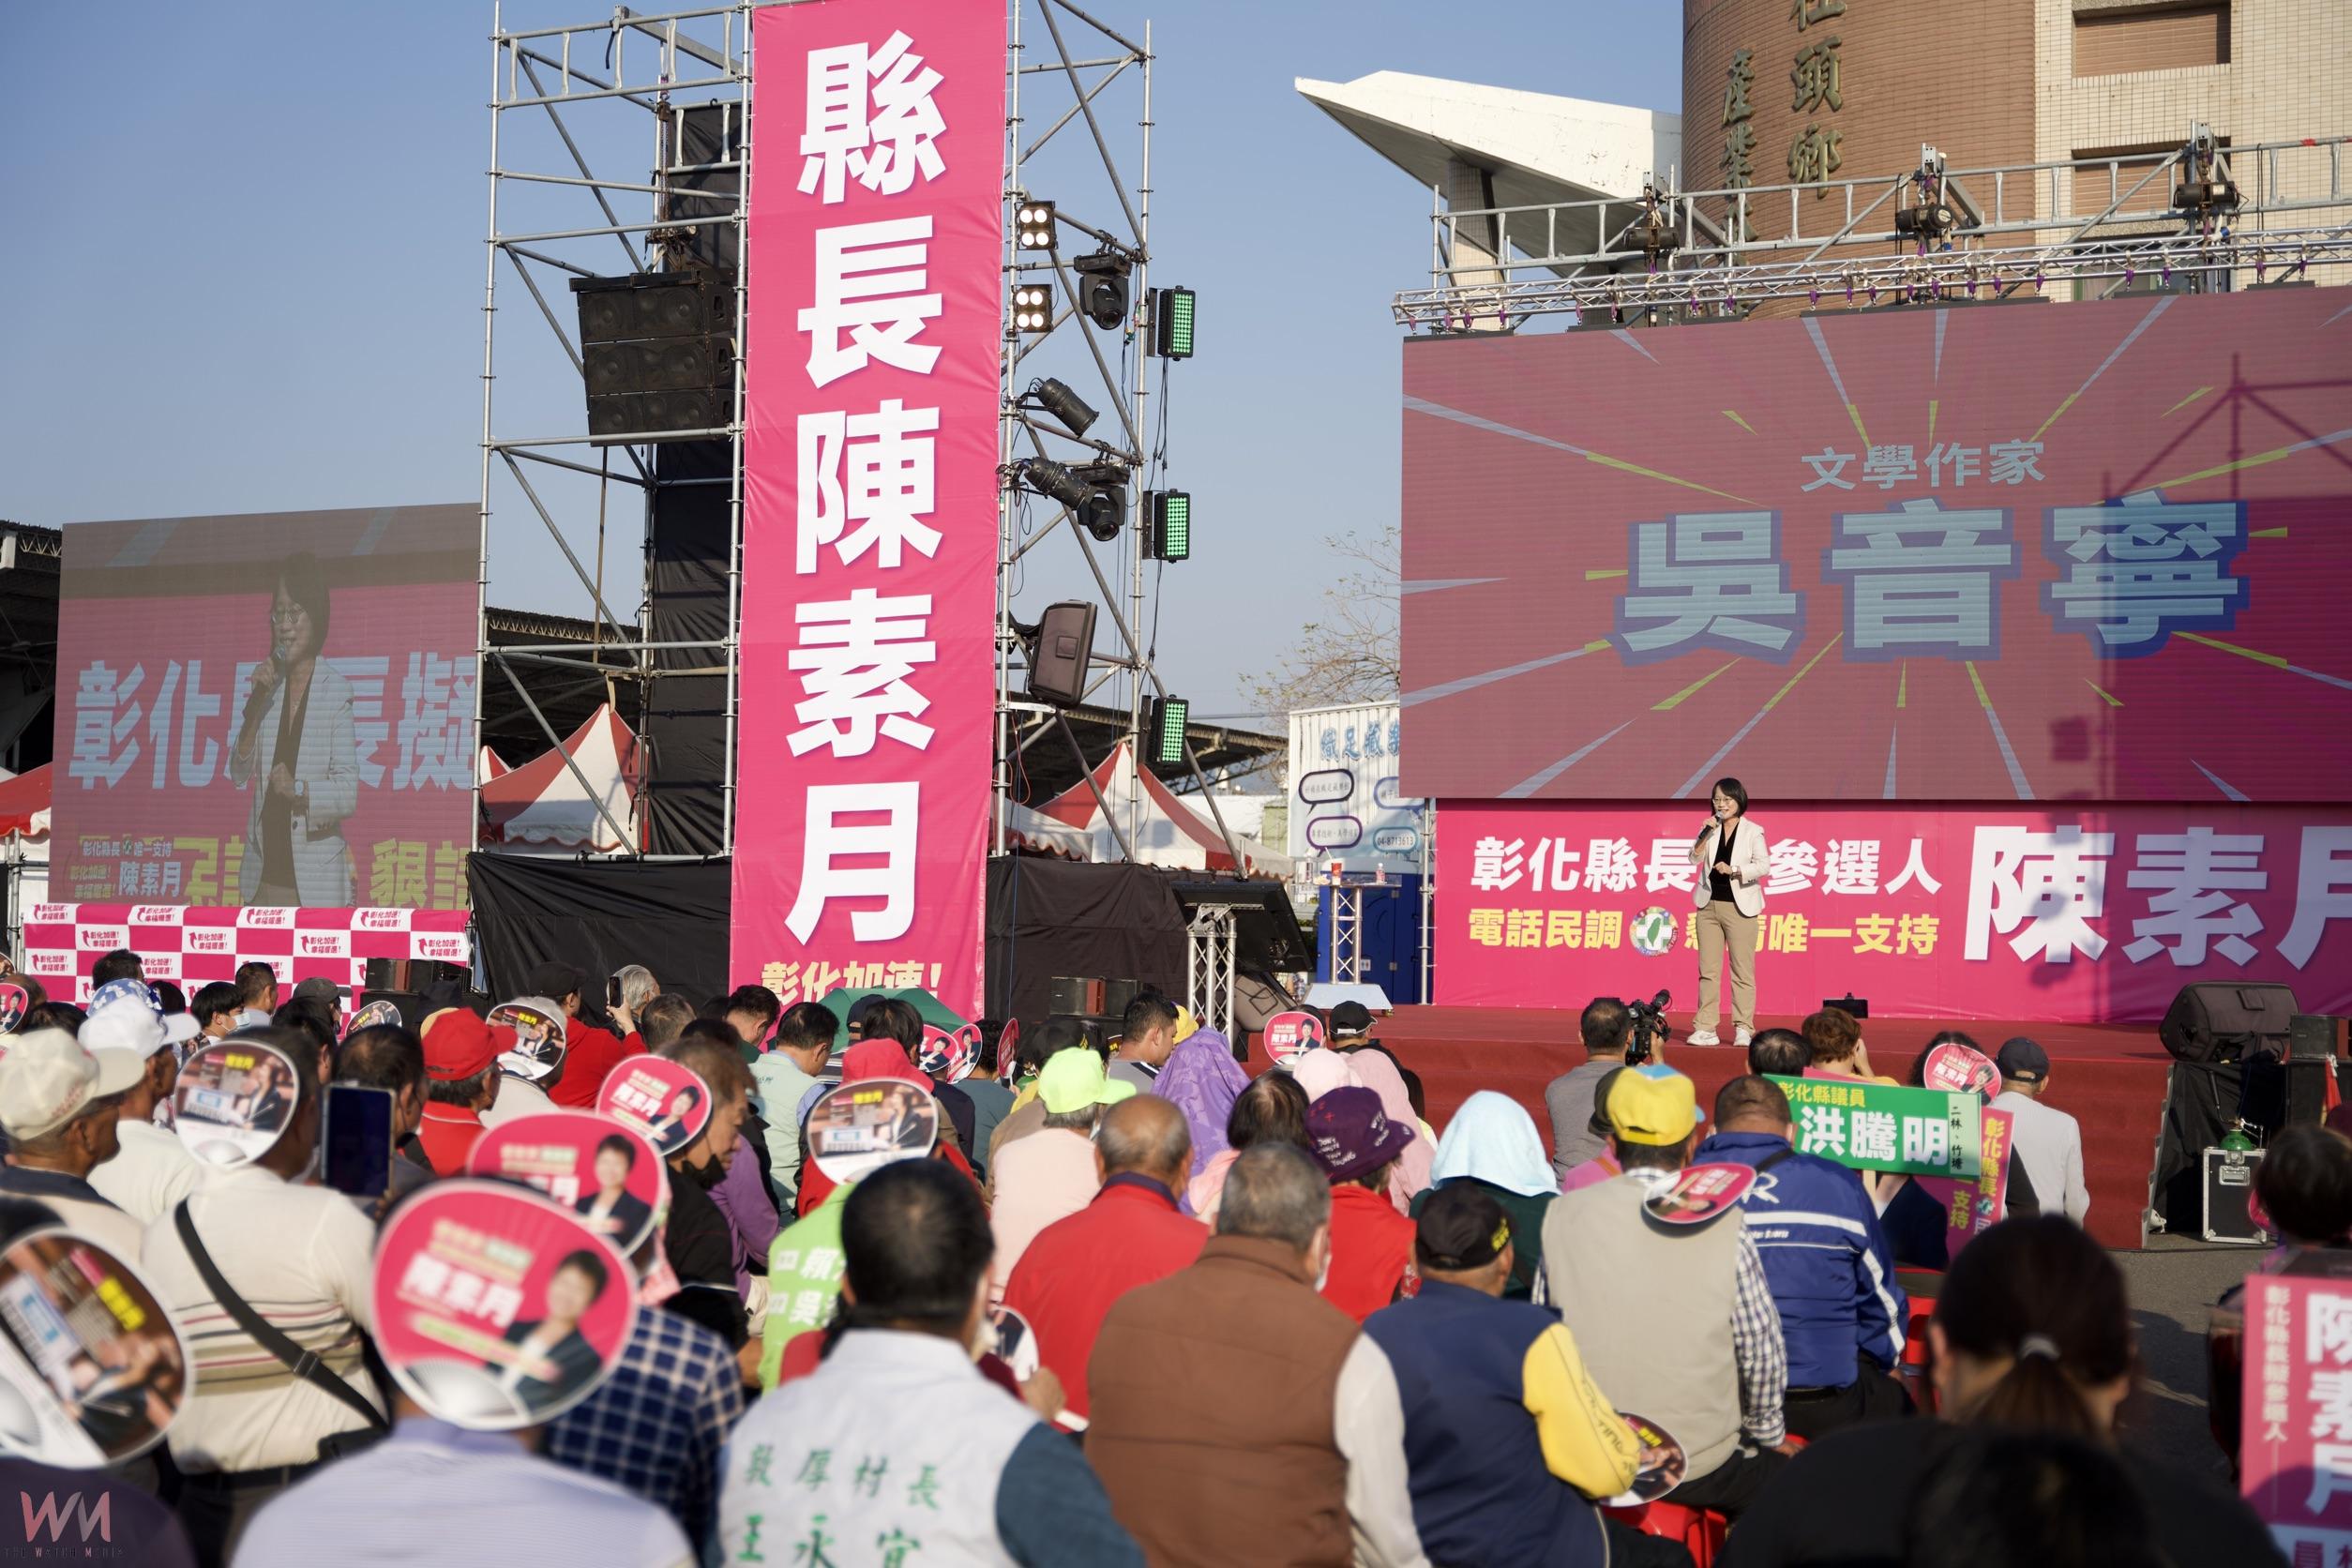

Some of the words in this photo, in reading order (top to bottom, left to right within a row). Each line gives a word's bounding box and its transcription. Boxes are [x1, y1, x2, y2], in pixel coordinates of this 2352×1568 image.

[784, 29, 947, 945] 縣長陳素月
[1801, 441, 2046, 492] 文學作家
[1620, 490, 2239, 654] 吳音寧
[118, 861, 182, 897] 陳素月
[1469, 909, 1623, 949] 電話民調
[1778, 1080, 1865, 1108] 彰化縣議員
